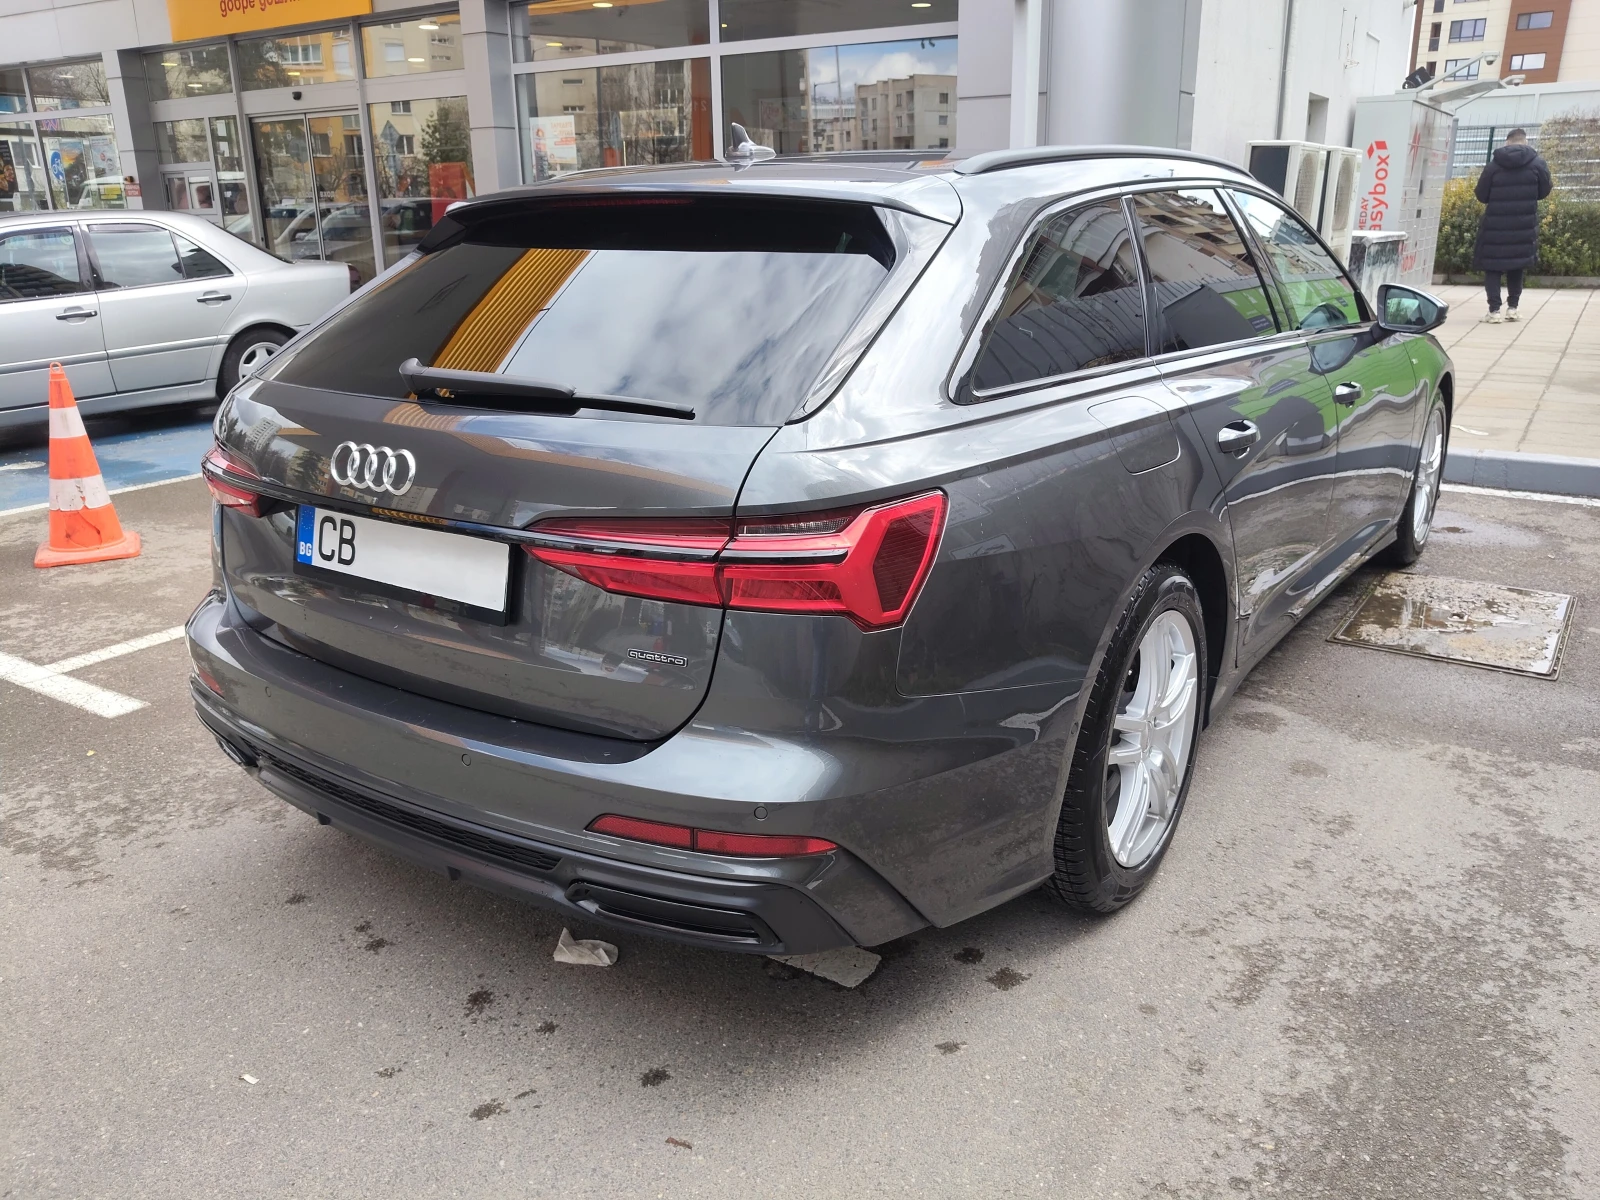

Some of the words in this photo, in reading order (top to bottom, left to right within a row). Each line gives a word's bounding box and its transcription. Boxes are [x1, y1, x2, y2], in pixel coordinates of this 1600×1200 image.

[1368, 153, 1390, 231] asybox
[1358, 197, 1369, 231] MEDAY
[299, 541, 312, 557] BG
[318, 515, 356, 566] CB
[629, 651, 684, 665] quattro
